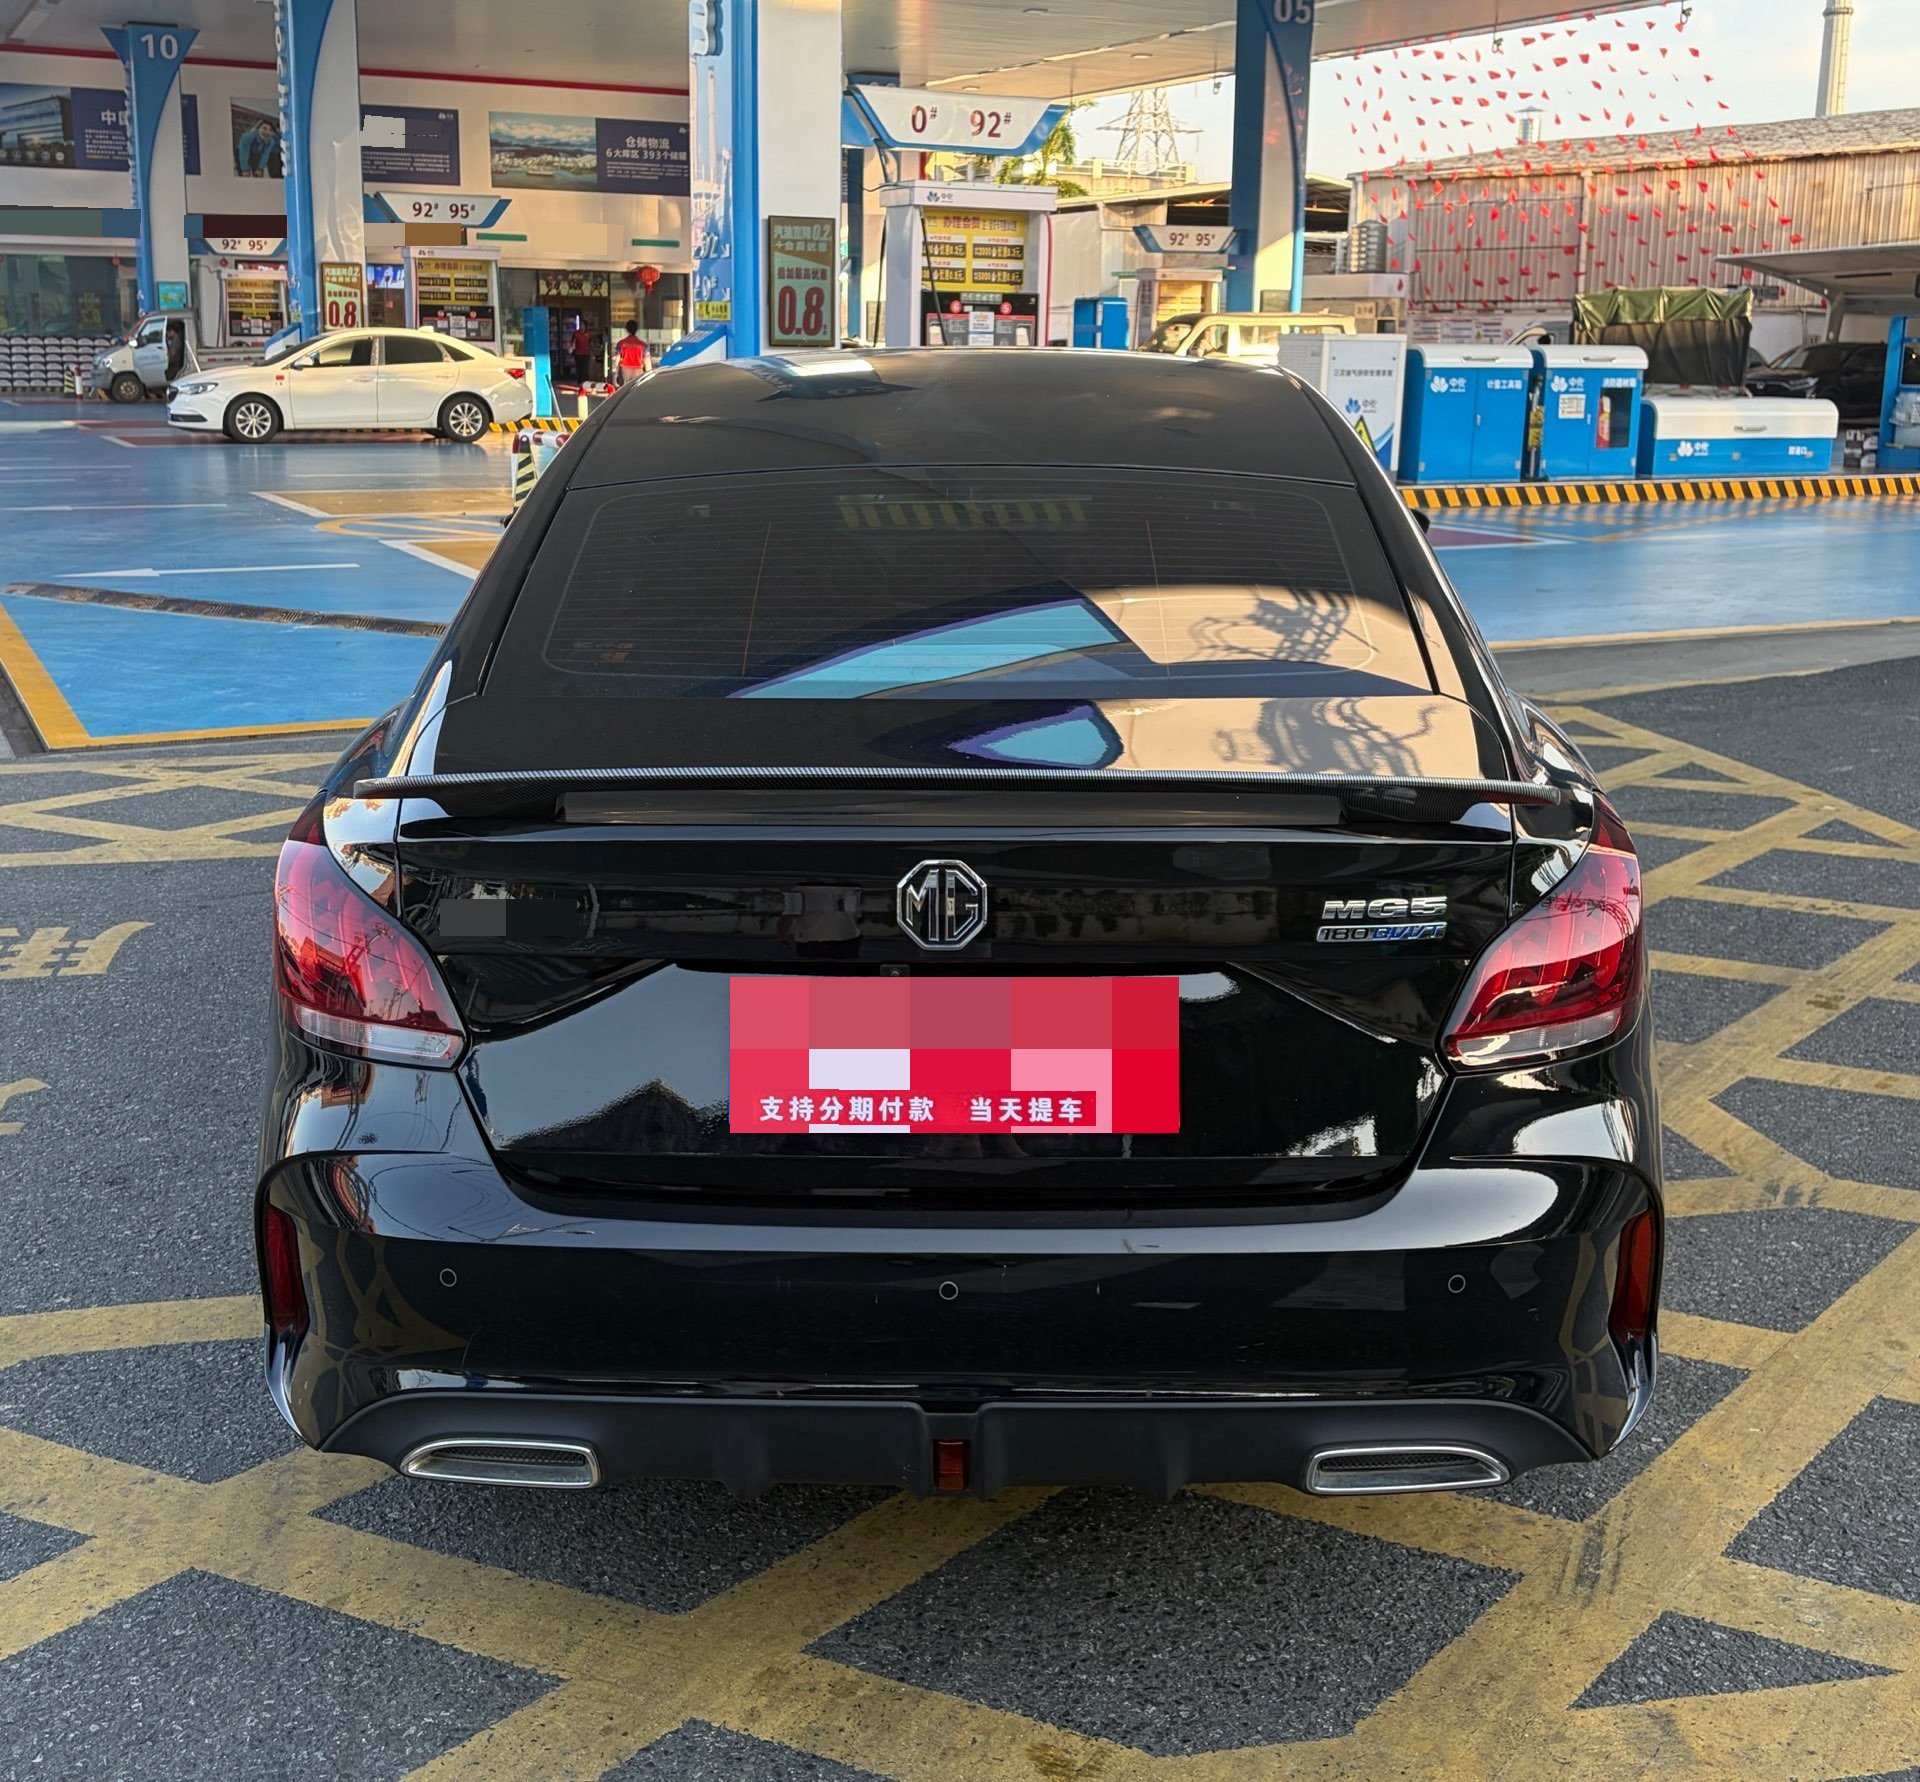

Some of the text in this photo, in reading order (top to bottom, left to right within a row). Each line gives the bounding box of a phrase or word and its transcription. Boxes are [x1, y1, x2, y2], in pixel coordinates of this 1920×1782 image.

[1274, 0, 1312, 24] 05
[140, 33, 179, 60] 10
[911, 105, 1012, 138] 0# 92#
[606, 148, 640, 159] 6大库区
[625, 136, 670, 149] 仓储物流
[412, 202, 476, 219] 92# 95#
[222, 239, 267, 251] 92# 95#
[1169, 232, 1216, 246] 92# 95#
[328, 300, 357, 328] 0.8
[778, 285, 826, 336] 0.8
[906, 869, 978, 942] MG
[1321, 896, 1448, 920] MG5
[758, 1096, 1084, 1124] 支持分期付款 当天提车
